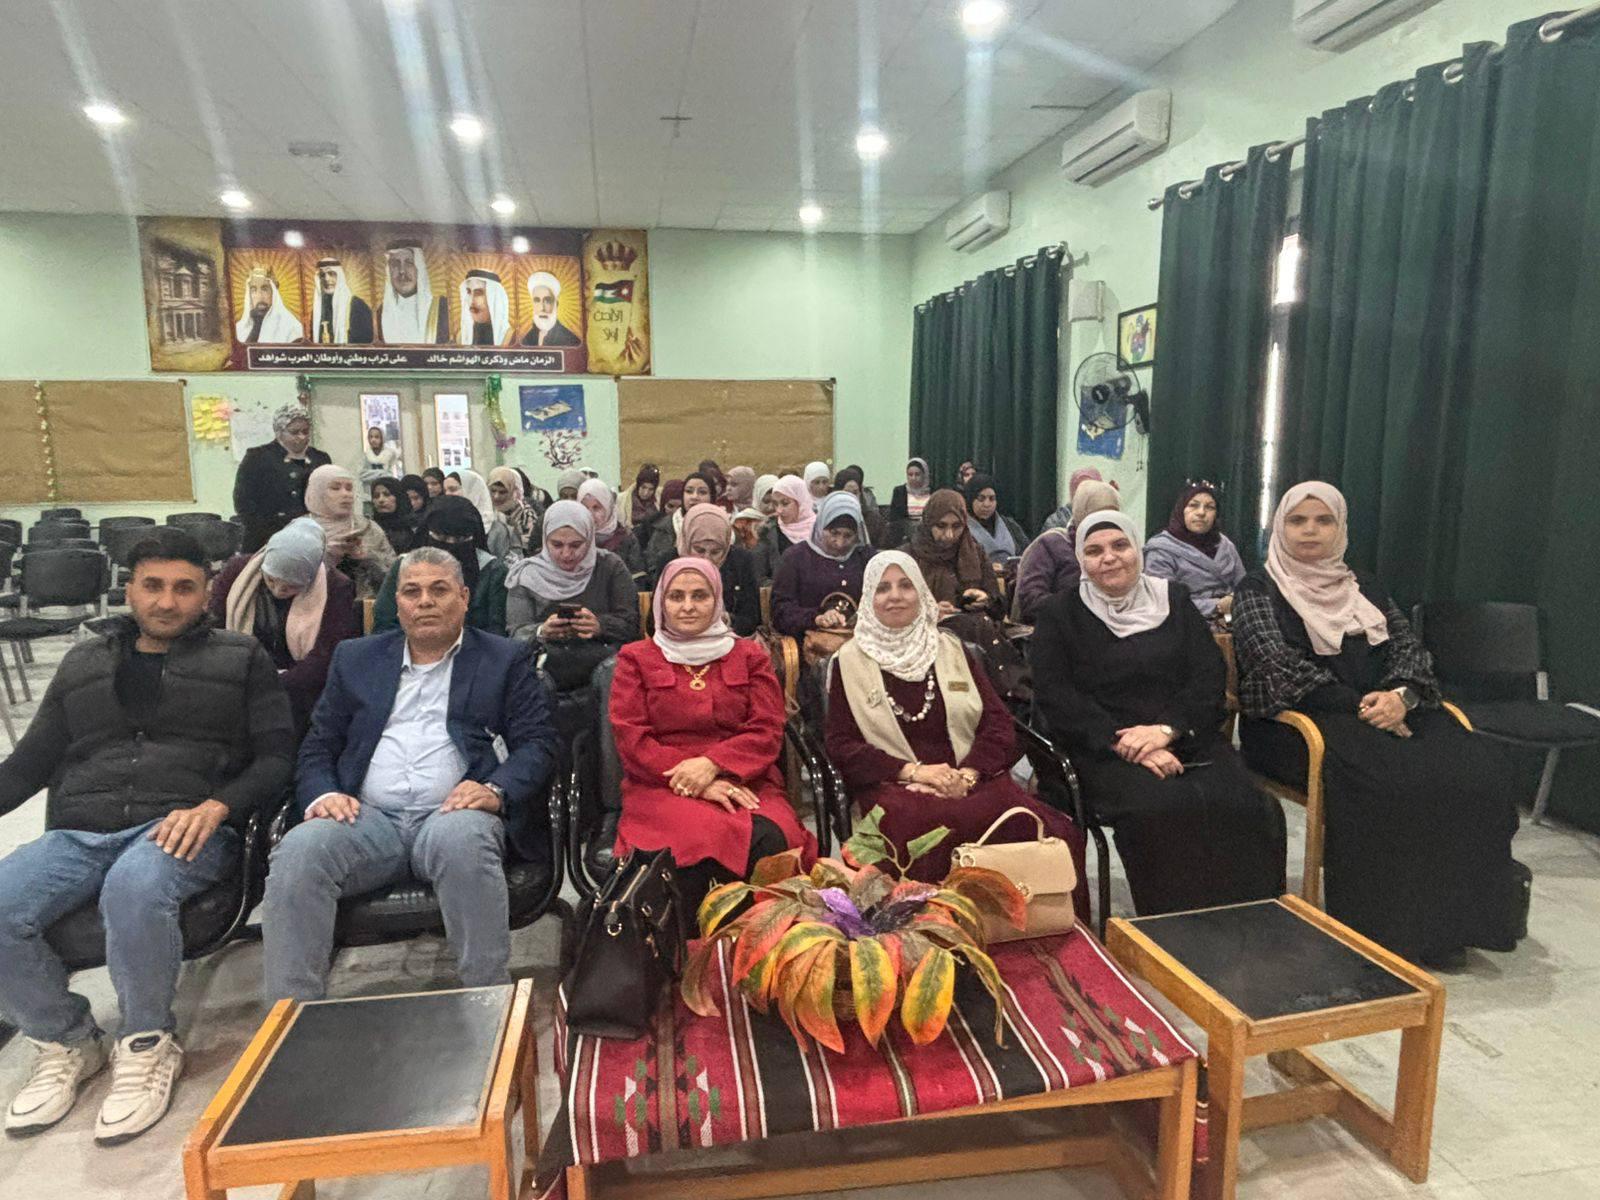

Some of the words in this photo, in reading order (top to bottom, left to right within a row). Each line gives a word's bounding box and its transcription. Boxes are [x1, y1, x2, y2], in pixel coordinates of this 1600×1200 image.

[258, 353, 287, 363] شواهد
[287, 353, 313, 365] العرب
[343, 353, 367, 366] وطني
[367, 353, 389, 365] تراب
[389, 354, 408, 364] على
[449, 354, 480, 365] الهواشم
[480, 354, 508, 366] وذكرى
[530, 356, 555, 366] الزمان
